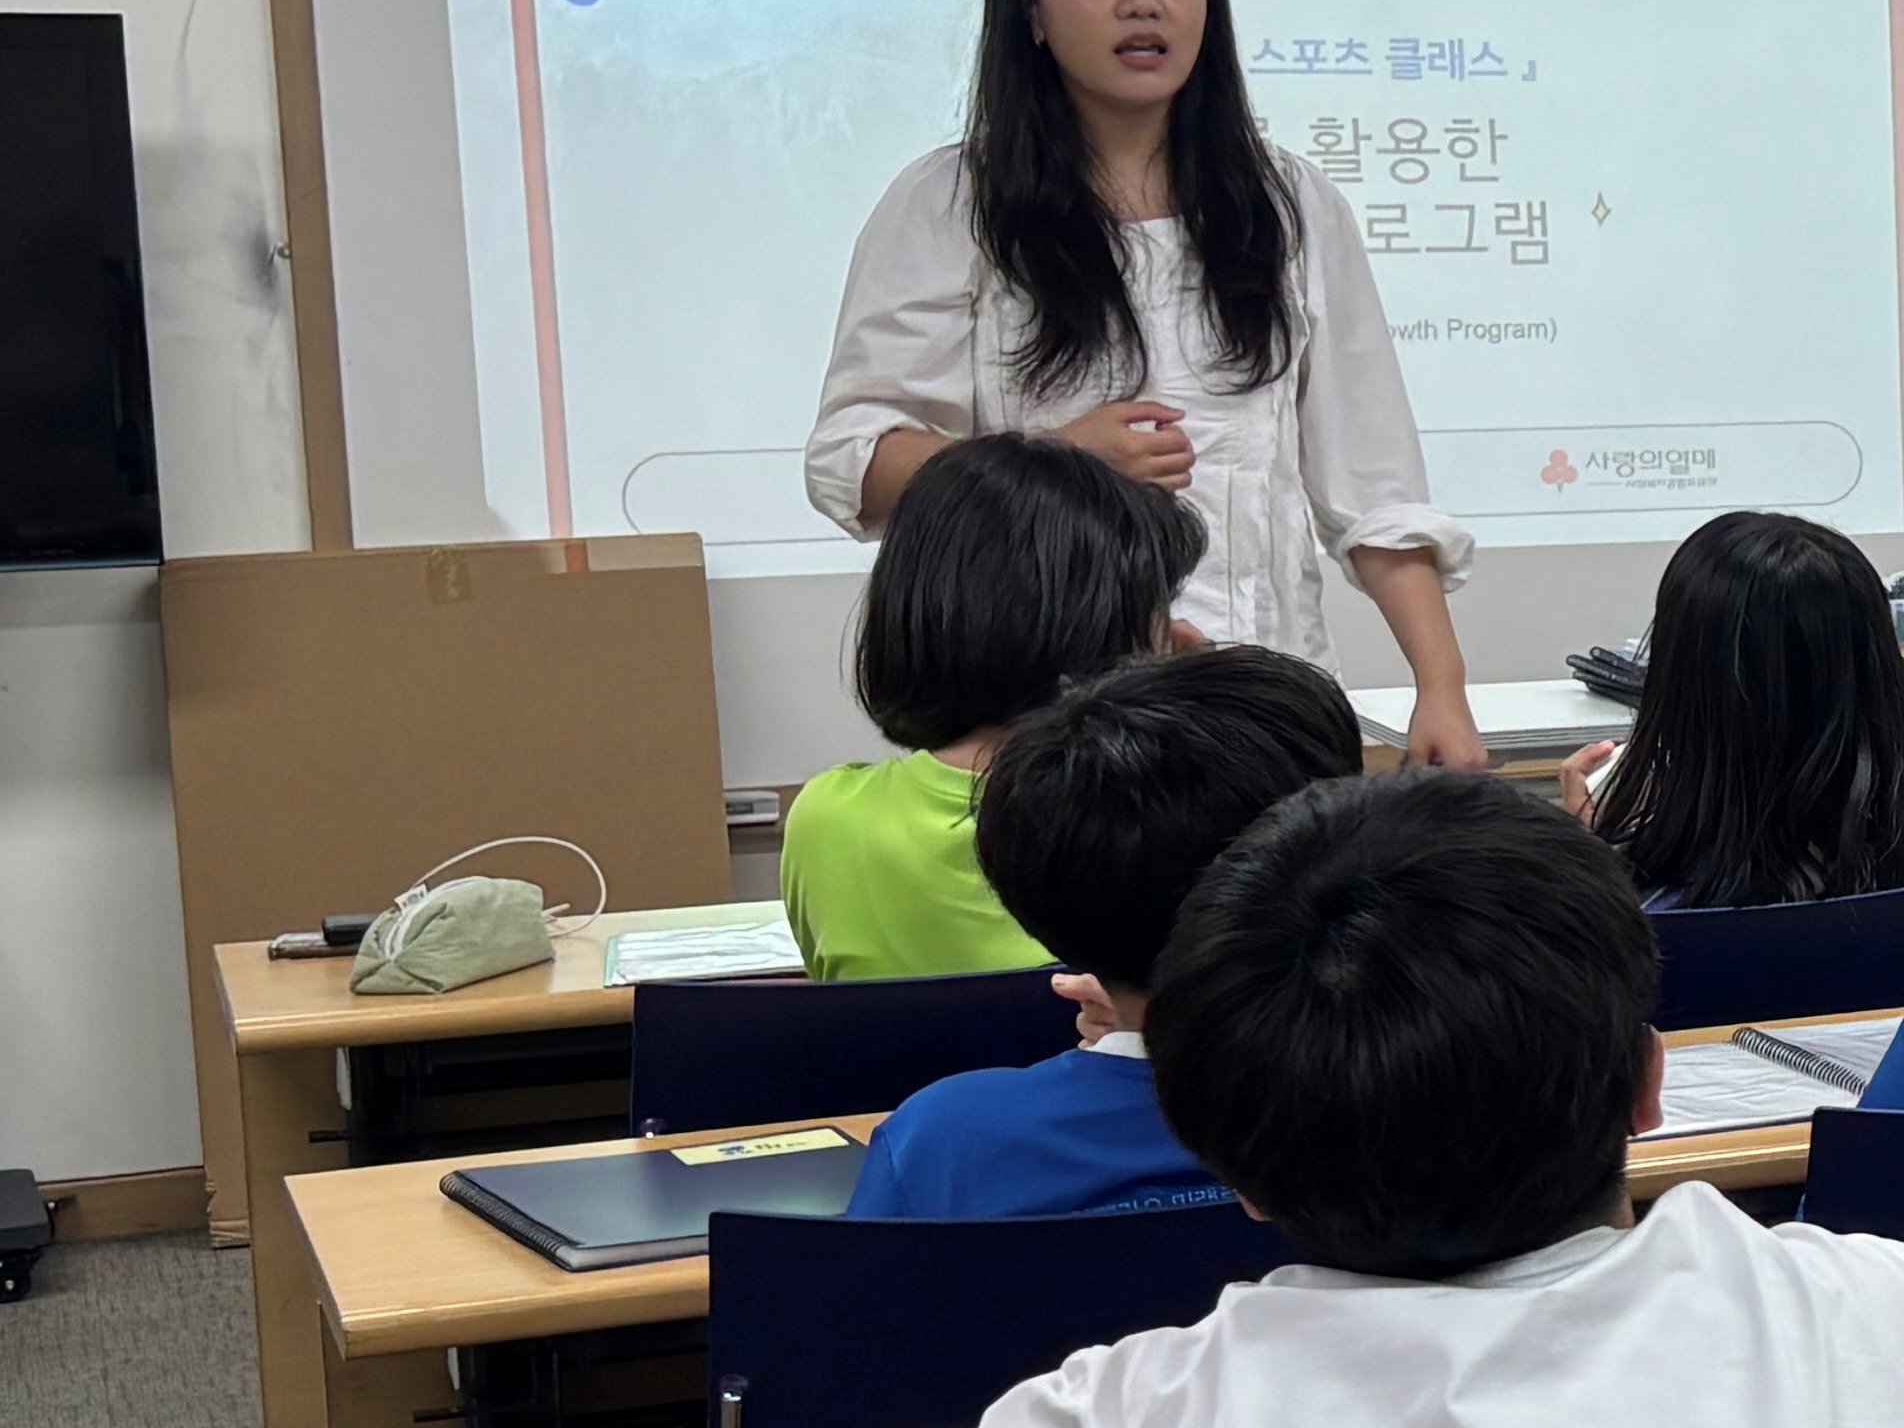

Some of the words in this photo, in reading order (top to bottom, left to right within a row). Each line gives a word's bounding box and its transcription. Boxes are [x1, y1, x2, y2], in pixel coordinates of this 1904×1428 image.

[1247, 37, 1373, 75] 스포츠
[1385, 37, 1508, 82] 클래스
[1305, 117, 1508, 185] 활용한
[1447, 318, 1558, 345] Program)
